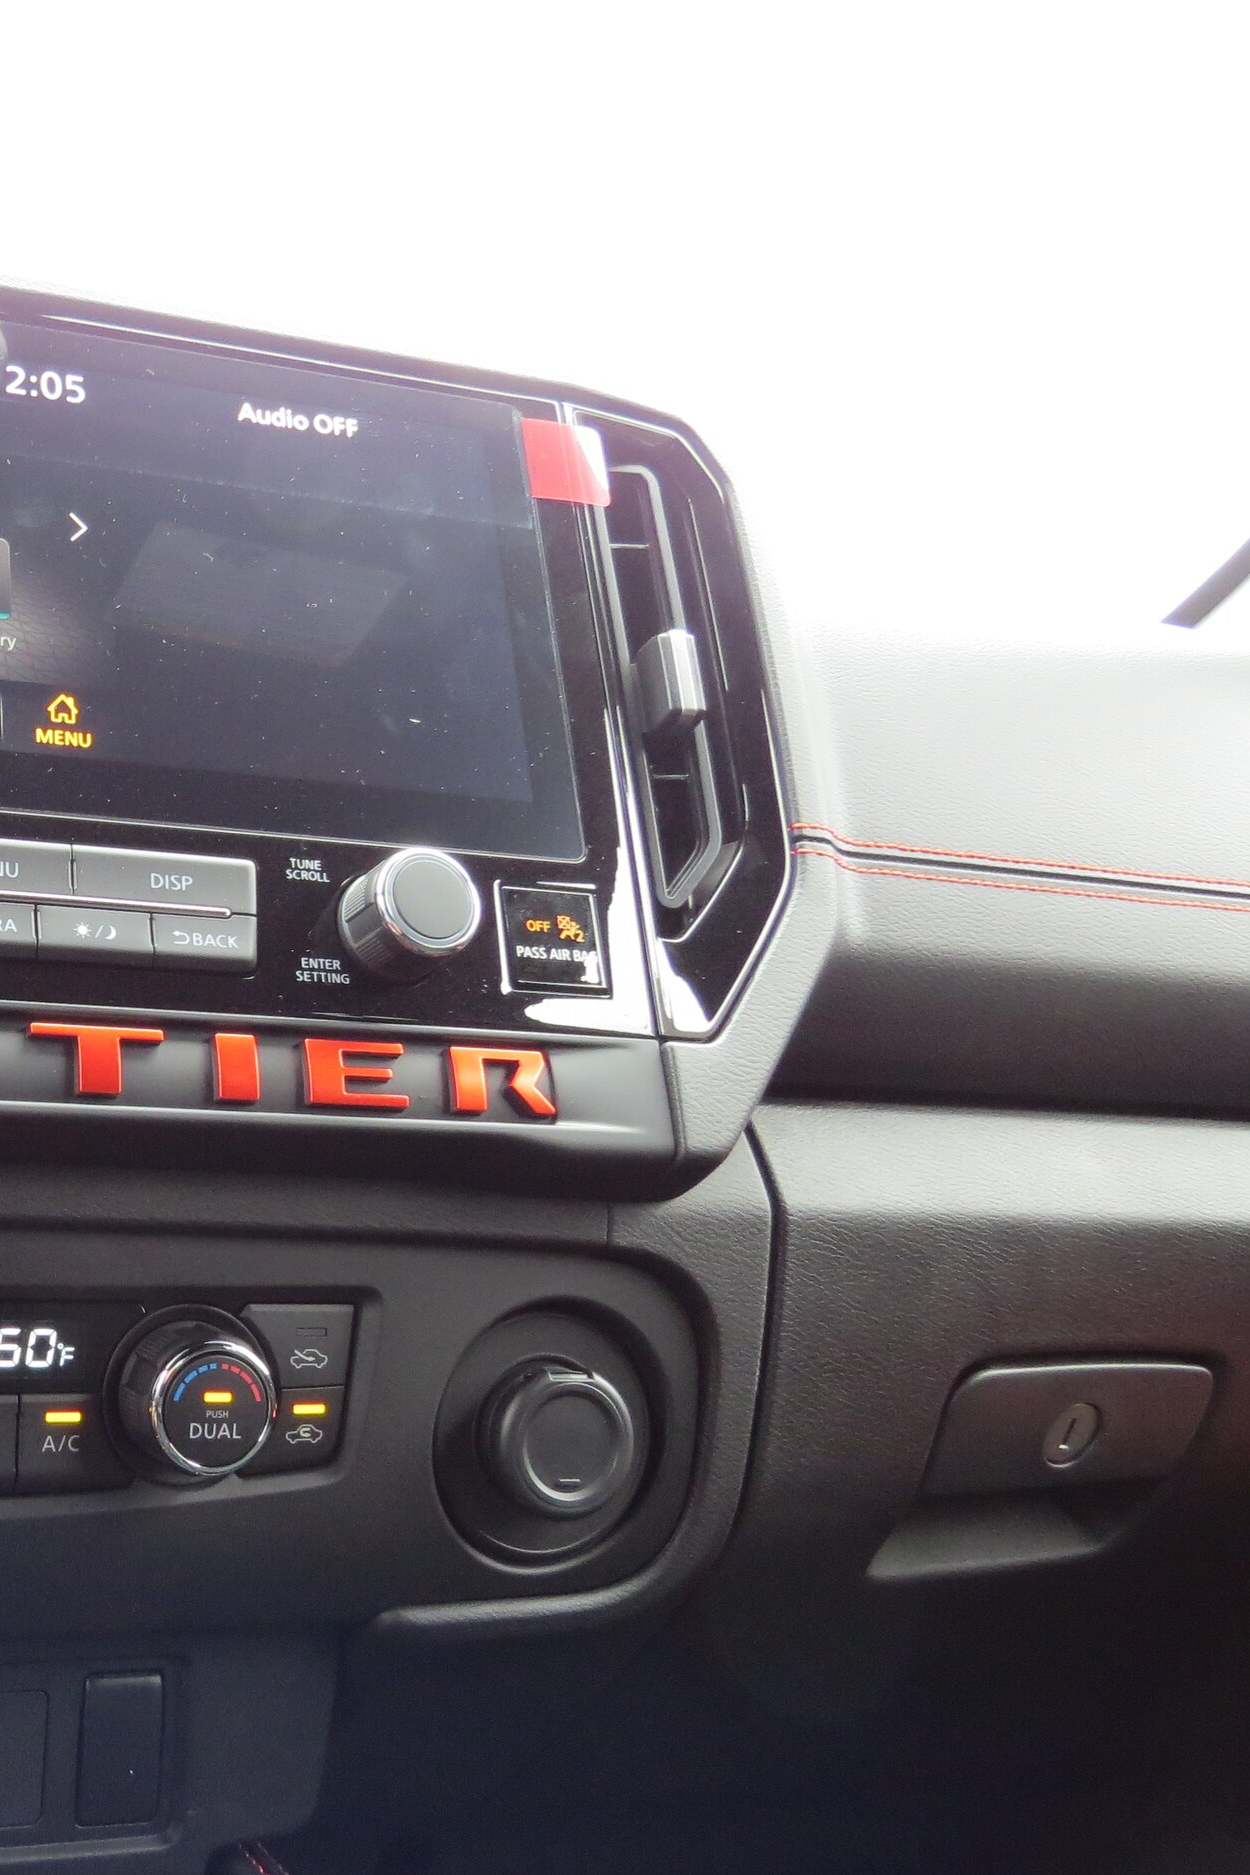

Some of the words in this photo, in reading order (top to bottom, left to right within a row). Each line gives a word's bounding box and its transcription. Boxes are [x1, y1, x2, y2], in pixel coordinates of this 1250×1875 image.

[237, 402, 309, 432] Audio
[313, 414, 359, 438] OFF
[35, 728, 92, 748] MENU
[289, 858, 322, 871] TUNE
[150, 872, 193, 891] DISP
[285, 868, 331, 883] SCROLL
[525, 919, 551, 932] OFF
[192, 933, 239, 949] BACK
[516, 945, 547, 959] PASS
[549, 948, 571, 961] AIR
[300, 957, 341, 971] ENTER
[295, 970, 350, 985] SETTING
[206, 1409, 229, 1418] PUSH
[189, 1422, 242, 1440] DUAL
[41, 1433, 80, 1453] A/C
